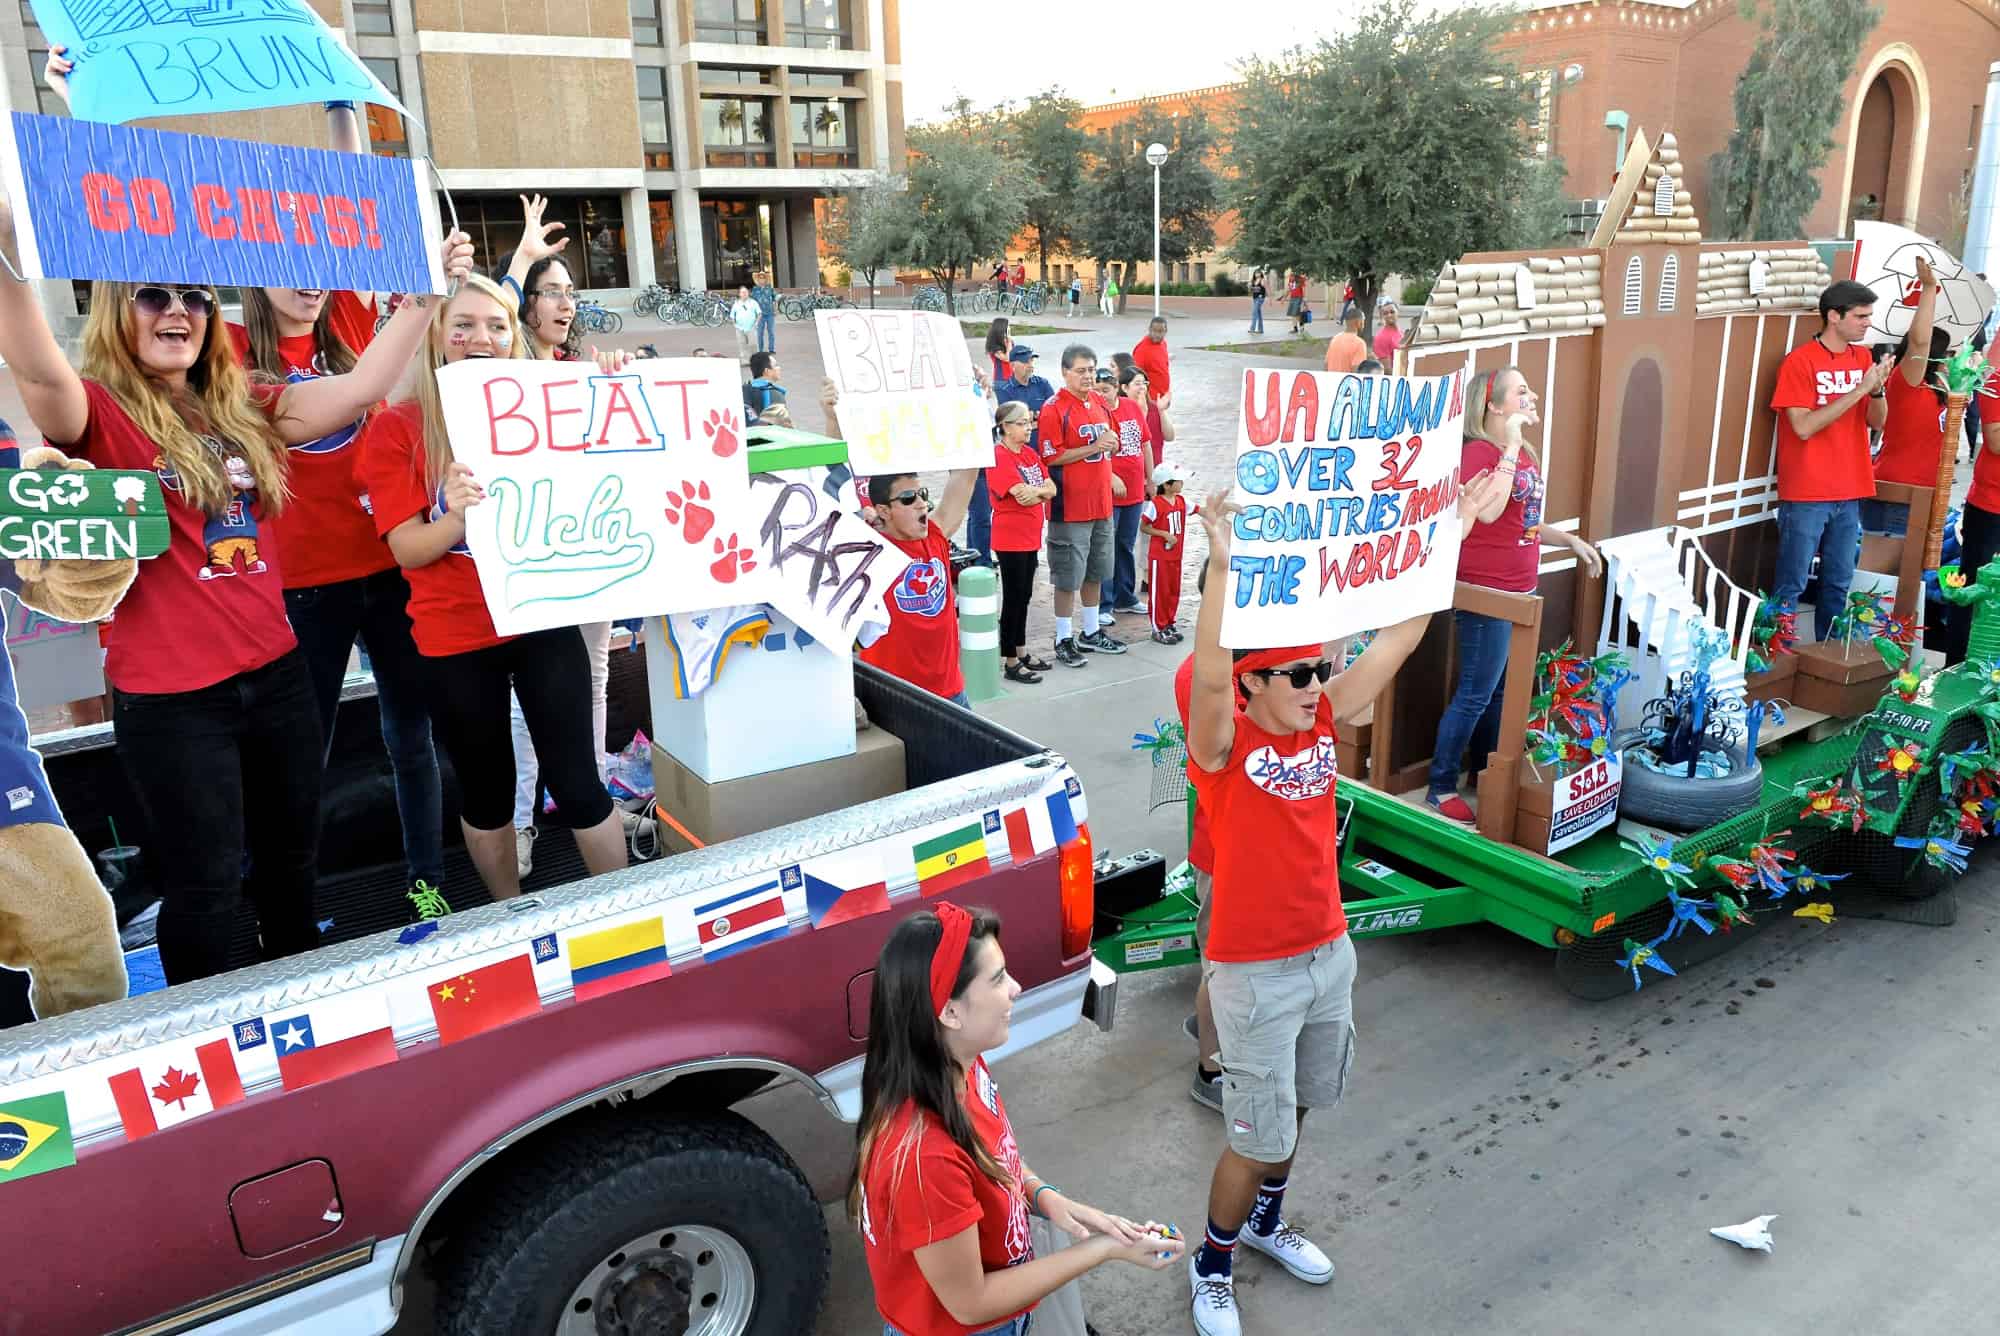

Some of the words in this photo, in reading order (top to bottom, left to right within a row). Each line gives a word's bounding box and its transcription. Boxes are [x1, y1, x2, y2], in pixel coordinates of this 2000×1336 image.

[81, 172, 176, 237] GO
[192, 183, 383, 250] CATS!
[828, 311, 972, 394] BEA
[483, 374, 710, 456] BEAT
[1245, 369, 1319, 447] UA
[1327, 374, 1449, 441] ALUMNI
[1237, 446, 1356, 495] OVER
[1371, 435, 1423, 491] 32
[0, 515, 138, 560] GREEN
[1233, 492, 1400, 542] COUNTRIES
[1231, 554, 1306, 608] THE
[1319, 521, 1437, 597] WORLD!
[1563, 799, 1583, 820] SAVE
[1583, 796, 1600, 812] OLD
